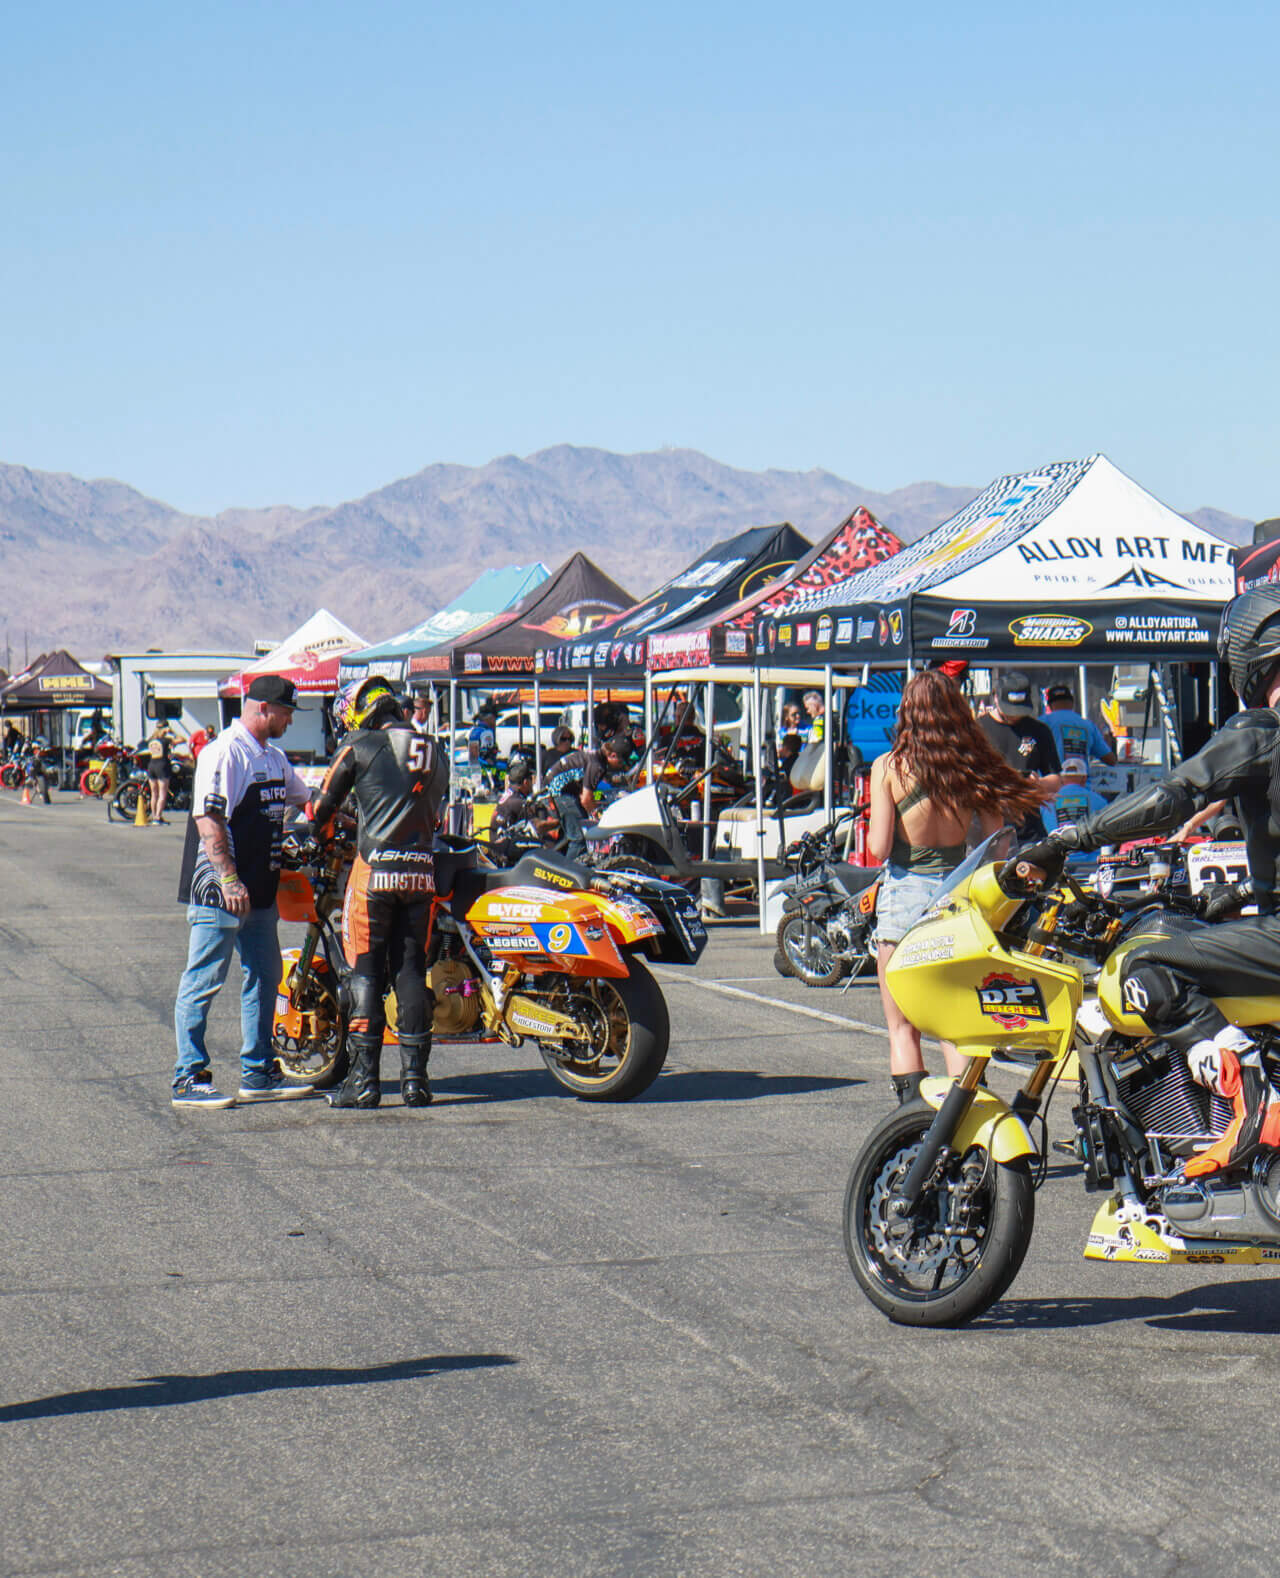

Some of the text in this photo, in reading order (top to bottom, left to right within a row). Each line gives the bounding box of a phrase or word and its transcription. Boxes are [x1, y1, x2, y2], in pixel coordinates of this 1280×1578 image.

[1017, 537, 1103, 565] ALLOY
[1115, 536, 1169, 560] ART
[1129, 616, 1199, 630] ALLOYARTUSA
[1018, 626, 1085, 641] SHADES
[1105, 630, 1209, 643] WWW.ALLOYART.COM
[407, 738, 433, 773] 51
[534, 866, 574, 888] SLYFOX
[487, 903, 544, 918] SLYFOX
[486, 937, 539, 948] LEGEND
[547, 924, 572, 953] 9
[981, 986, 1036, 1005] DP
